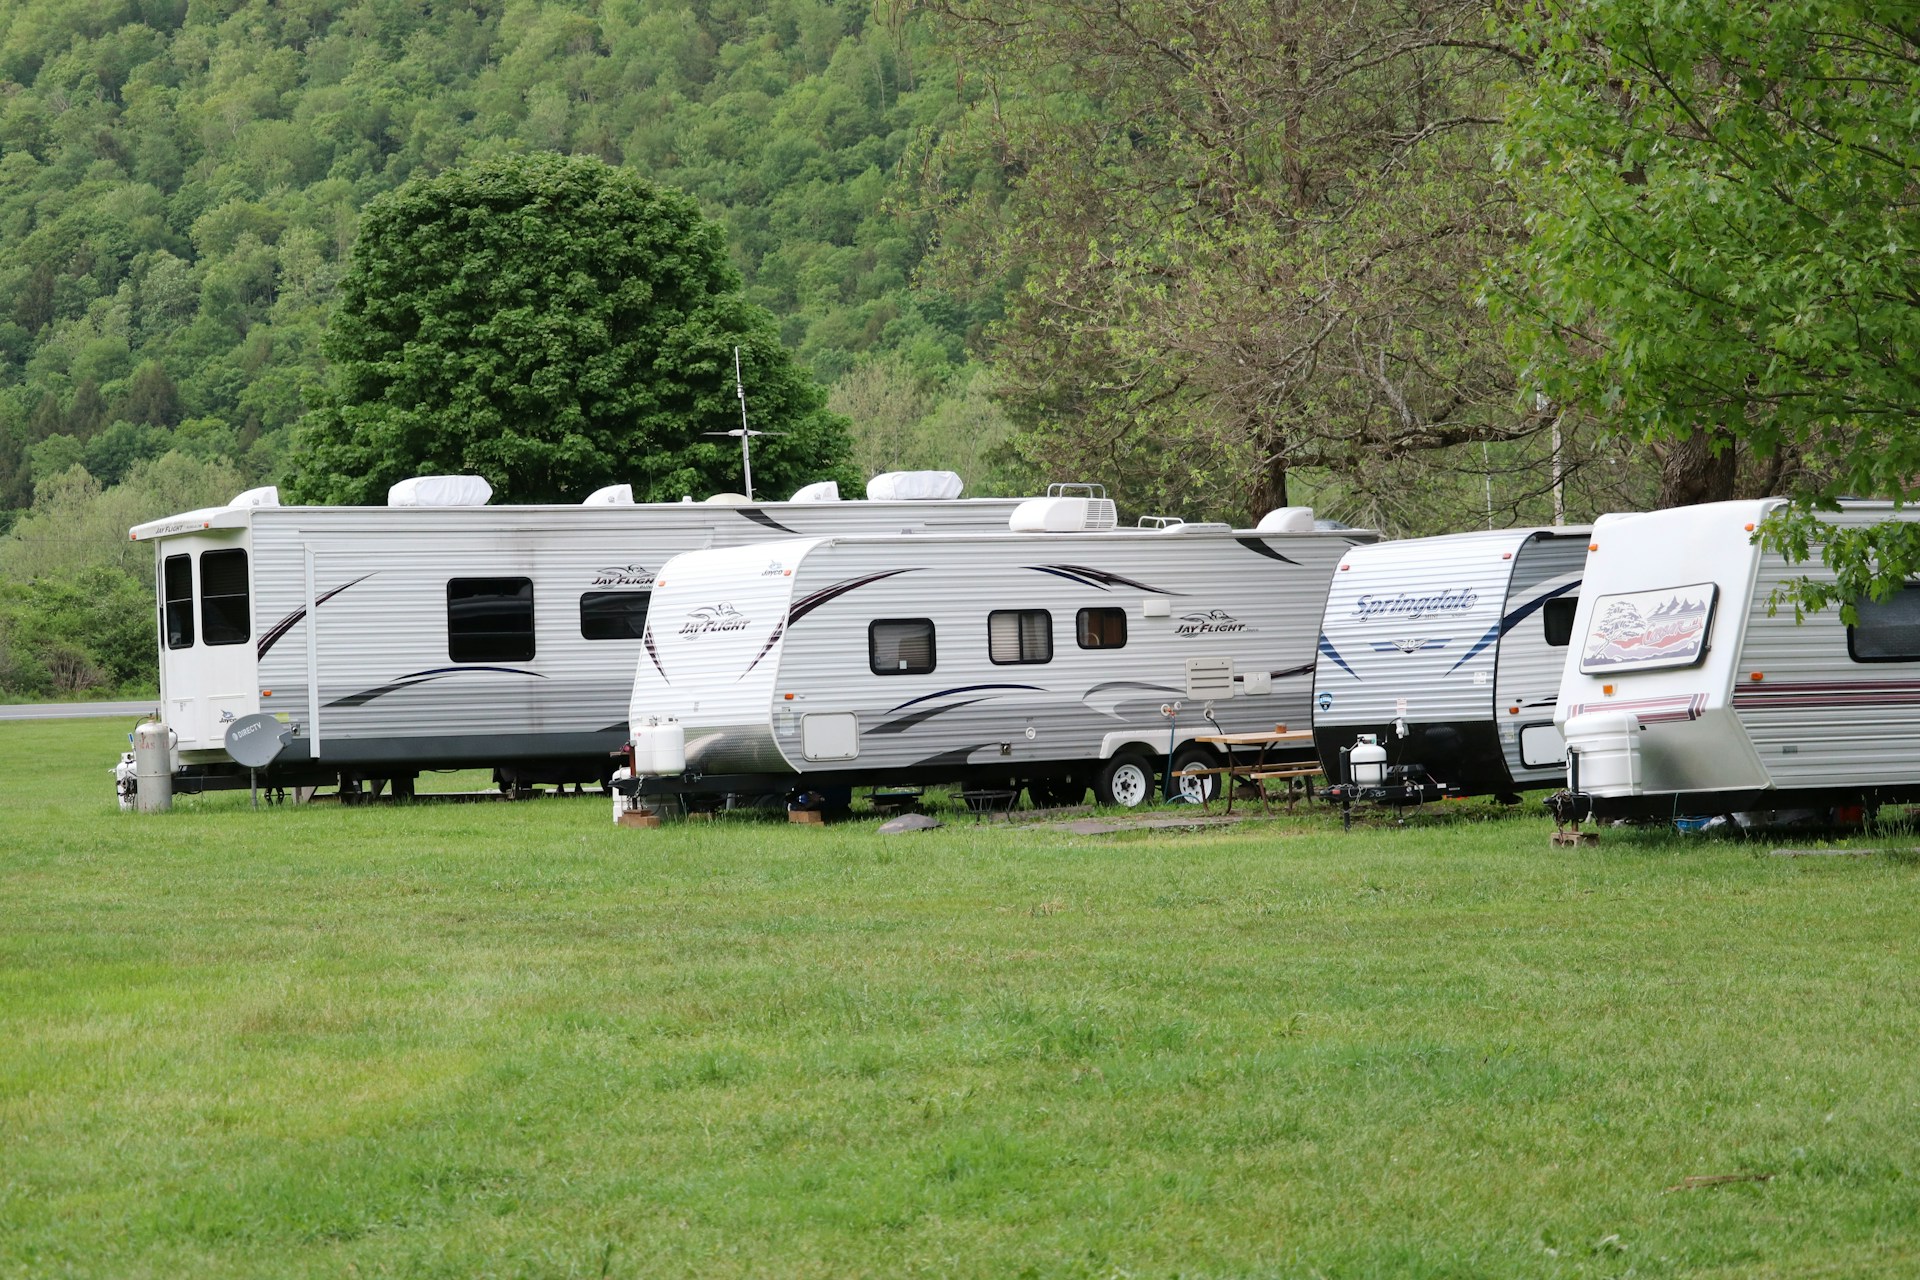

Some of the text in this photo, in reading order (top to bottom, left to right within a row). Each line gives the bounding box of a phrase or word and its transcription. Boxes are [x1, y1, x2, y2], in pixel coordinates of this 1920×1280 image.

[761, 569, 783, 577] Jayco
[591, 577, 655, 585] JAY FLIGH
[1352, 587, 1479, 621] Springdale
[678, 620, 751, 634] JAY FLIGHT
[1174, 624, 1200, 634] JAY
[1199, 623, 1246, 633] FLIGHT
[237, 722, 261, 738] DIRECTV
